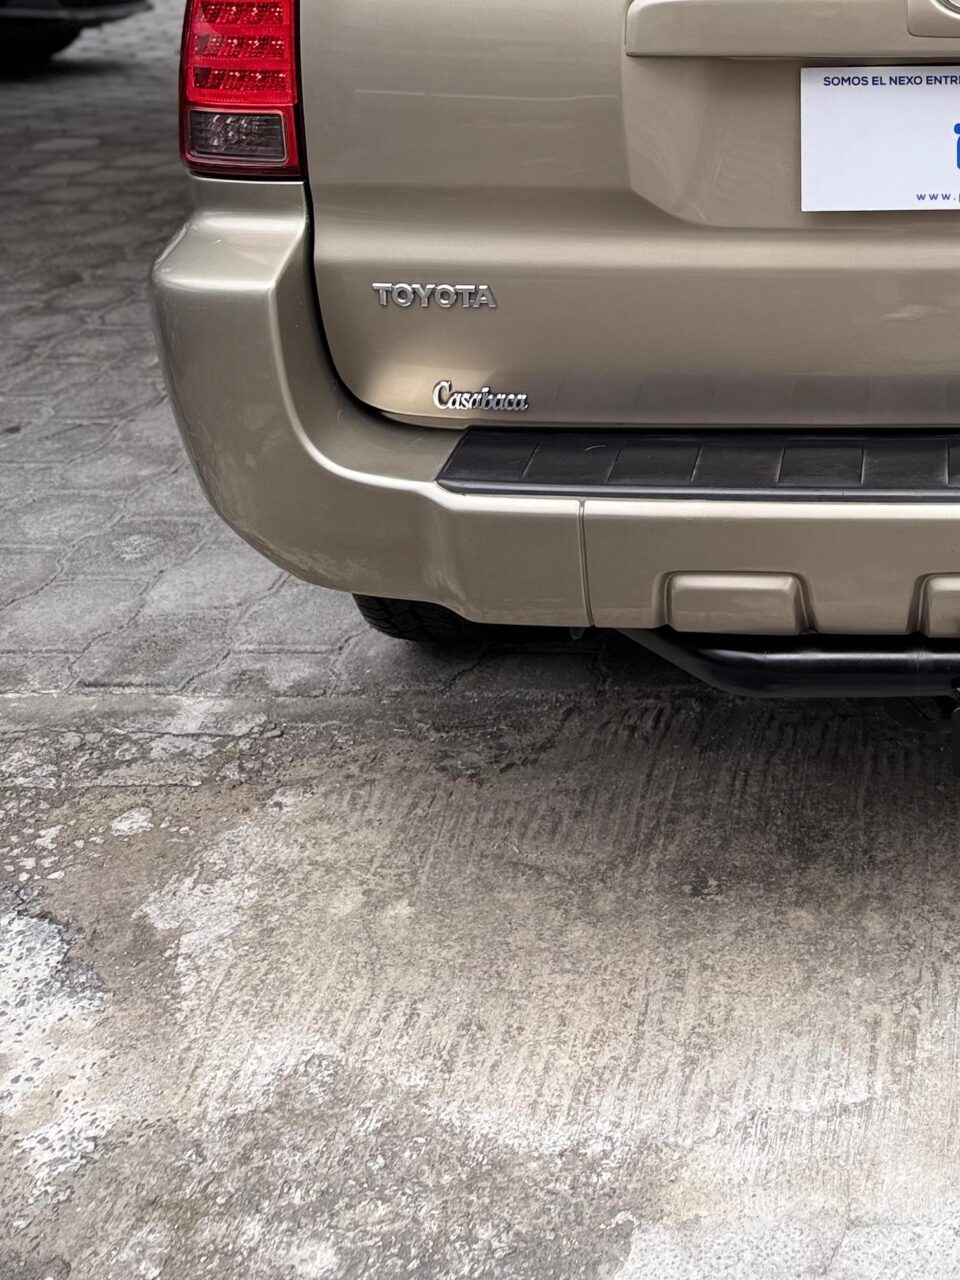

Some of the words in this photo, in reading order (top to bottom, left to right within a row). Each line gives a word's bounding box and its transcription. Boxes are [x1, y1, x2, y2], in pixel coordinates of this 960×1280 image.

[823, 76, 869, 87] SOMOS
[871, 76, 887, 86] EL
[889, 75, 923, 86] NEXO
[372, 282, 498, 308] TOYOTA
[432, 380, 529, 411] Casabaca
